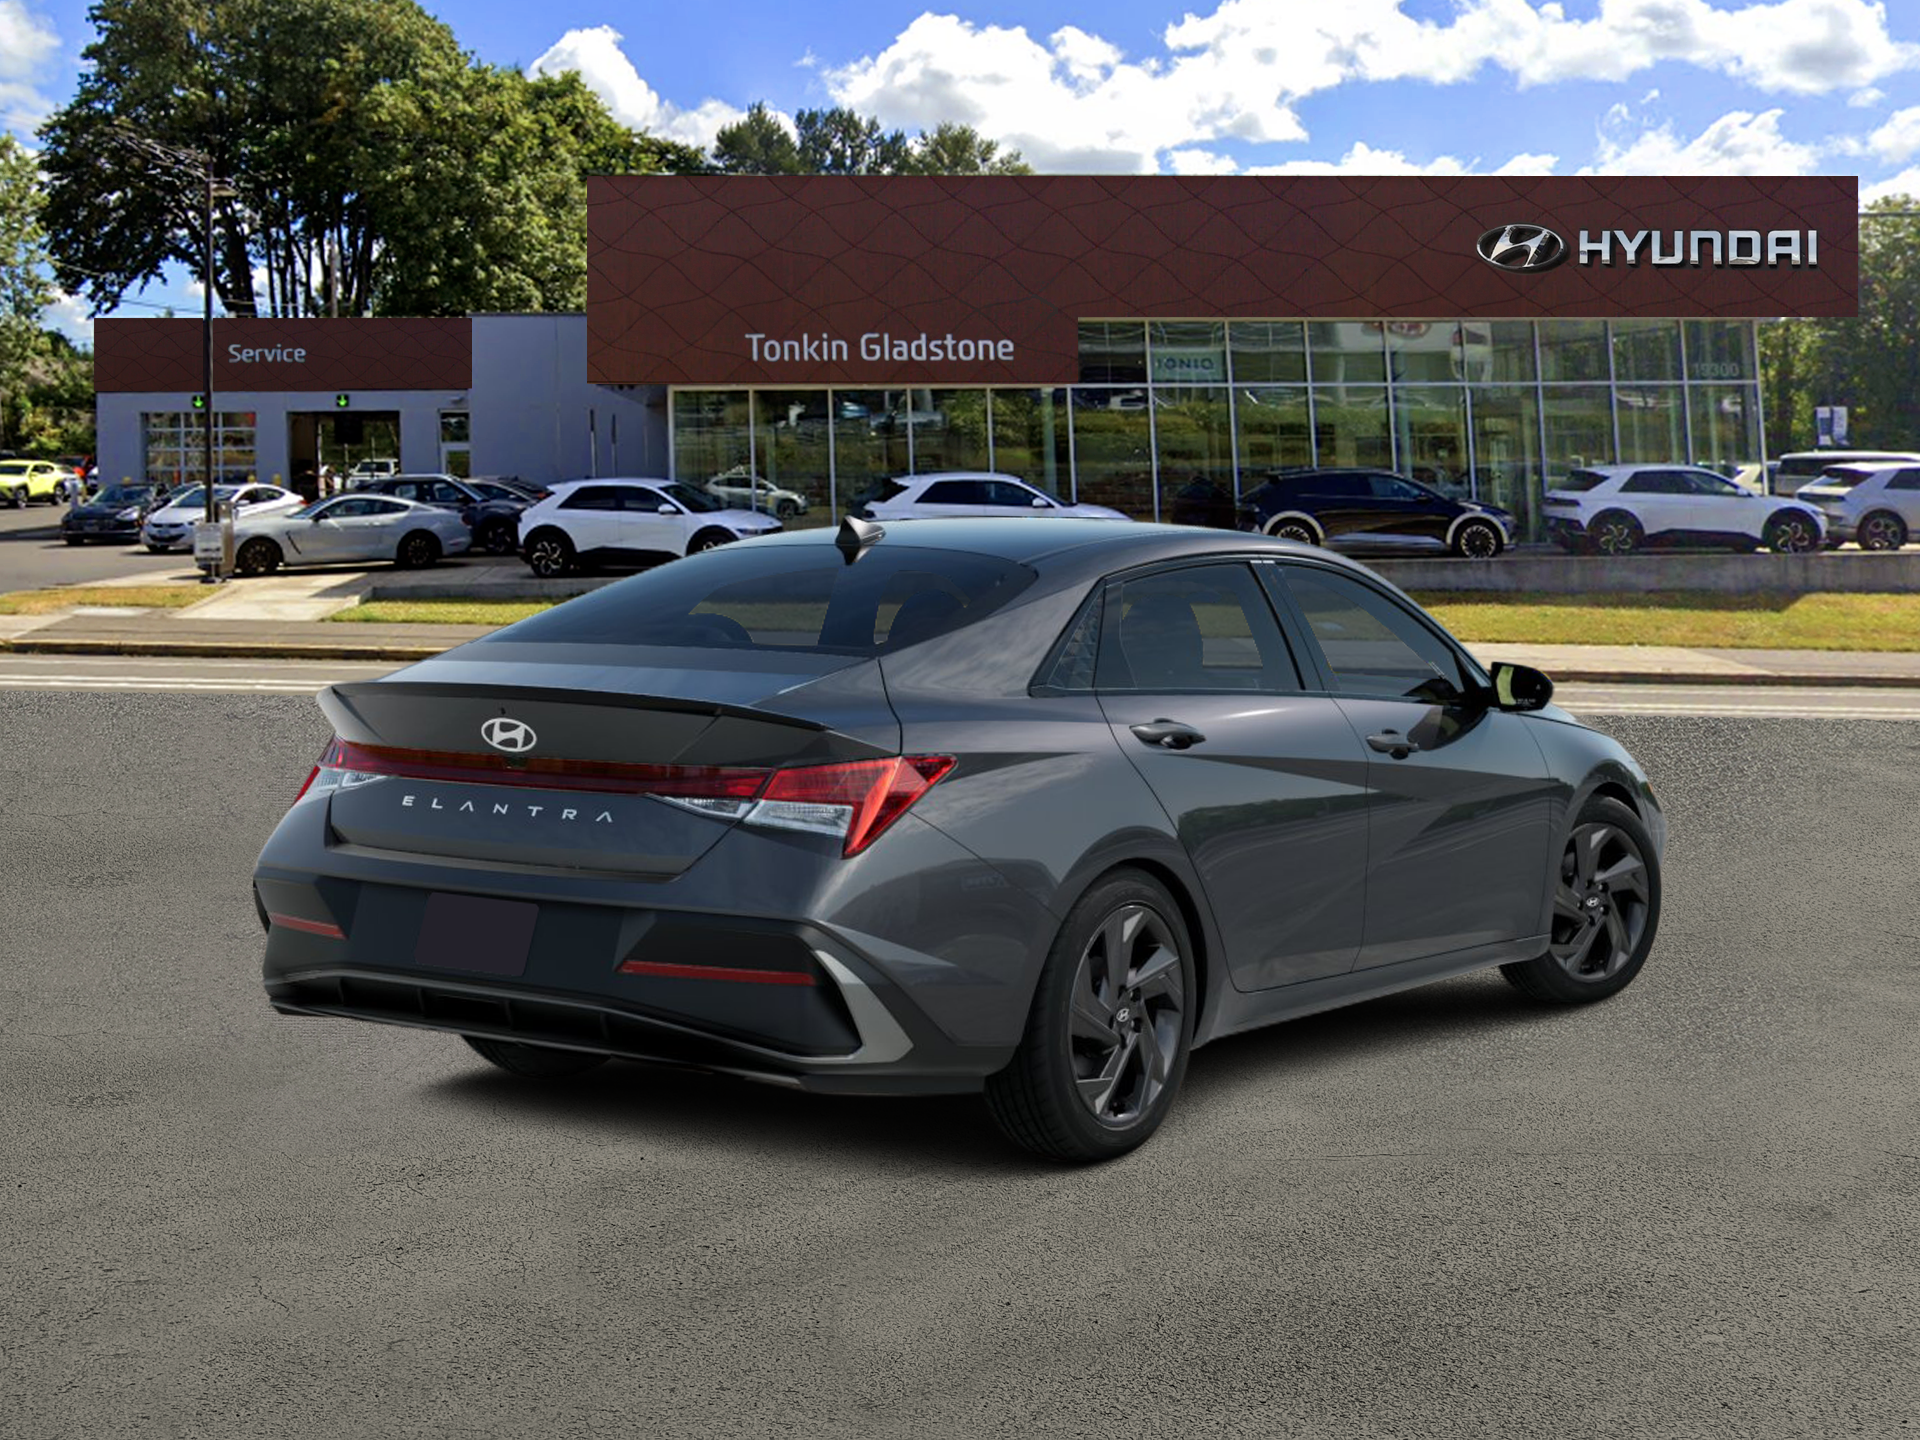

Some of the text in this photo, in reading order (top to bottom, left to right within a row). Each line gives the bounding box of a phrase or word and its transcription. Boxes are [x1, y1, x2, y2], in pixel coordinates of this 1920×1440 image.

[1578, 229, 1818, 266] HYUNDAI
[227, 343, 307, 363] Service
[744, 332, 1015, 362] Tonkin Gladstone
[401, 795, 613, 823] ELANTRA
